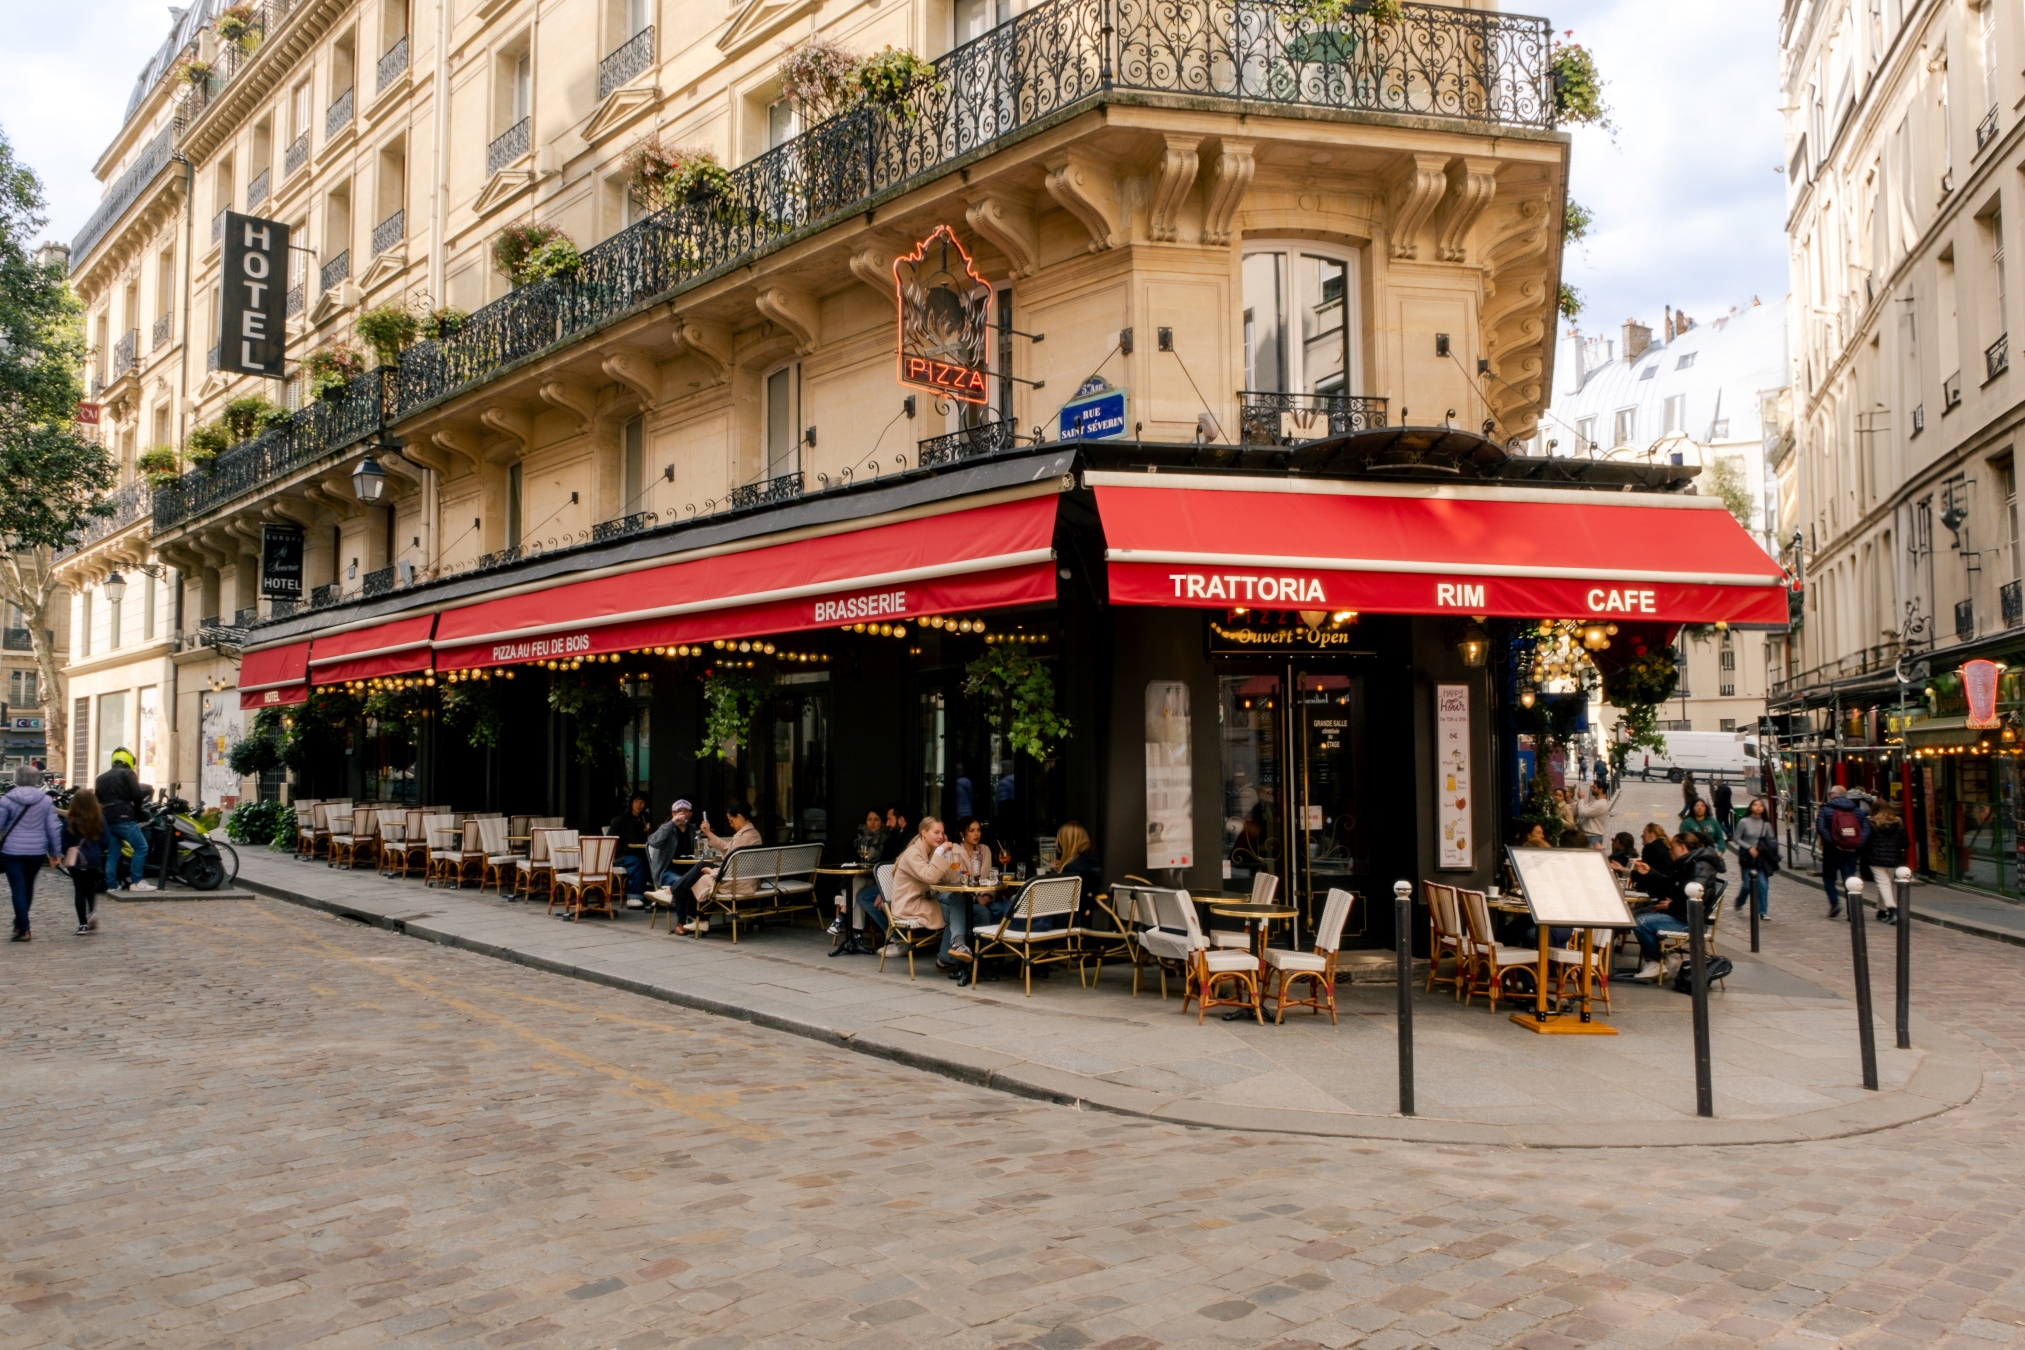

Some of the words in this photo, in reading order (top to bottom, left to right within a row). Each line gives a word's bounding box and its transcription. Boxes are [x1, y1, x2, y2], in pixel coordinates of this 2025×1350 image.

[242, 221, 271, 370] HOTEL
[911, 358, 984, 391] PIZZA
[1083, 407, 1102, 420] RUE
[1087, 416, 1124, 433] SÉVERIN
[266, 534, 302, 542] EUROPE
[264, 577, 302, 591] HOTEL
[1169, 574, 1326, 602] TRATTORIA
[1437, 583, 1485, 607] RIM
[1587, 589, 1657, 613] CAFE
[815, 591, 906, 622] BRASSERIE
[1238, 628, 1294, 643] Ouvert
[1307, 628, 1349, 649] Open
[493, 644, 517, 661] PIZZA
[517, 642, 530, 659] AU
[531, 640, 549, 657] FEU
[551, 638, 565, 655] DE
[566, 634, 590, 653] BOIS
[264, 691, 281, 703] HOTEL
[1443, 689, 1465, 698] HAPPY
[1440, 698, 1466, 712] Hour
[1313, 719, 1332, 727] GRANDE
[1333, 719, 1348, 727] SALLE
